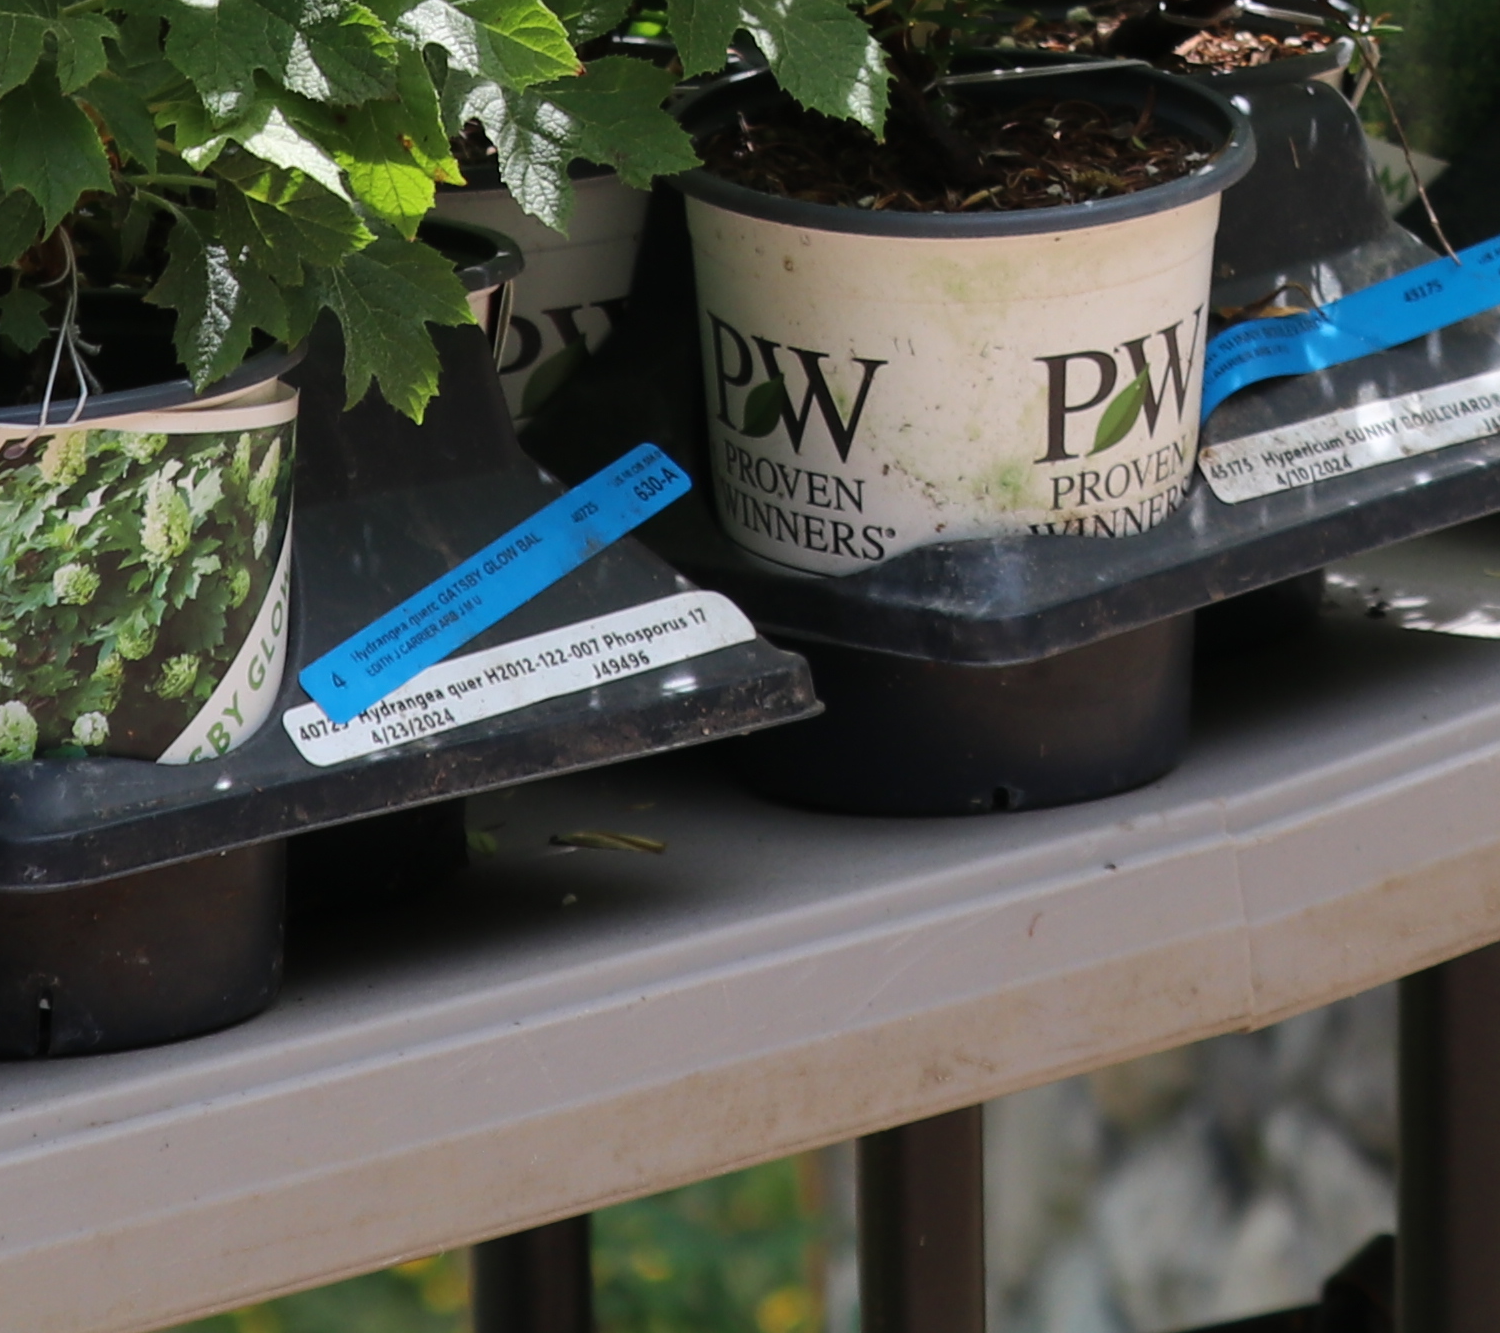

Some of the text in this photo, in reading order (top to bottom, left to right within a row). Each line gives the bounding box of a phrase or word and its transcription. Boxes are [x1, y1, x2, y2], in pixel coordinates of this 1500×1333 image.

[706, 308, 888, 464] PW
[1033, 304, 1203, 466] PW
[633, 468, 681, 502] 630-A
[725, 438, 866, 515] PROVEN
[1051, 434, 1189, 512] PROVEN
[1209, 458, 1254, 480] 45175
[1261, 437, 1344, 468] Hypericum
[1346, 419, 1399, 446] SUNNY
[1276, 455, 1353, 485] 4/10/2024
[350, 532, 543, 664] Hydrangea querc GATSBY GLOW BAL
[357, 687, 445, 725] Hydrangea
[447, 675, 484, 700] quer
[483, 641, 603, 686] H2012-122-007
[604, 616, 688, 652] Phosporus
[688, 607, 708, 626] 17
[364, 653, 397, 677] EDITH
[399, 619, 442, 653] CARRIER
[440, 605, 462, 626] ARB
[331, 673, 346, 690] 4
[370, 651, 652, 747] 4/23/2024 J49496
